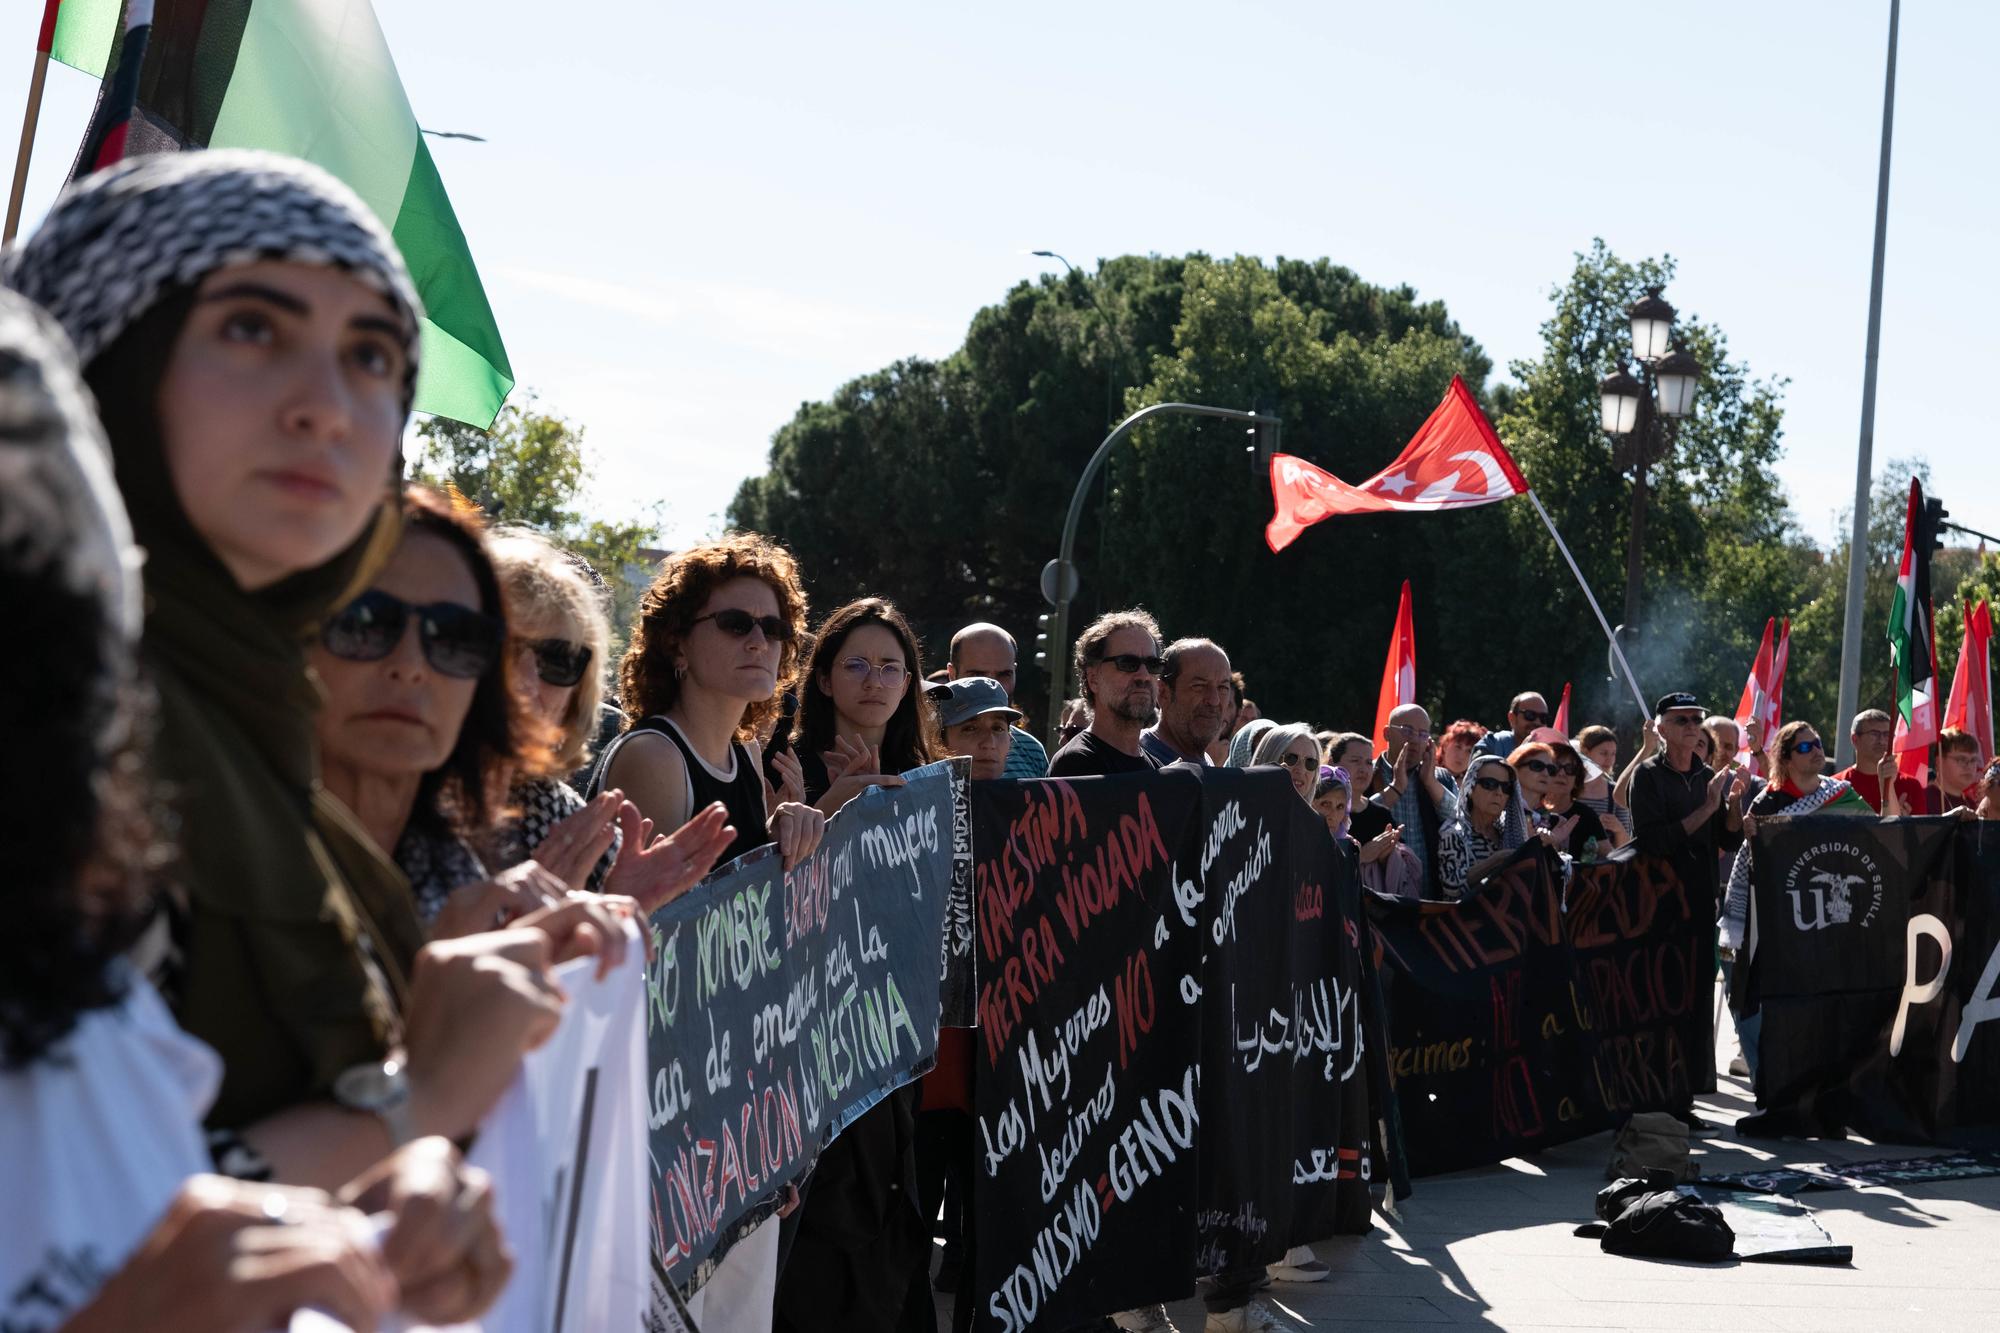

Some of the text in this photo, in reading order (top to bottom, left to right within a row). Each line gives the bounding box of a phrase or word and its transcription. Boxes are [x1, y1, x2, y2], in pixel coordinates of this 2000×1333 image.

[861, 801, 938, 900] mujeres
[1786, 842, 1883, 929] UNIVERSIDAD DE SEVILLA
[697, 880, 782, 1011] NOMBRE
[706, 1007, 733, 1095] de
[1115, 949, 1155, 1071] NO
[979, 983, 1111, 1178] Las Mujeres
[1041, 1061, 1116, 1203] decimos
